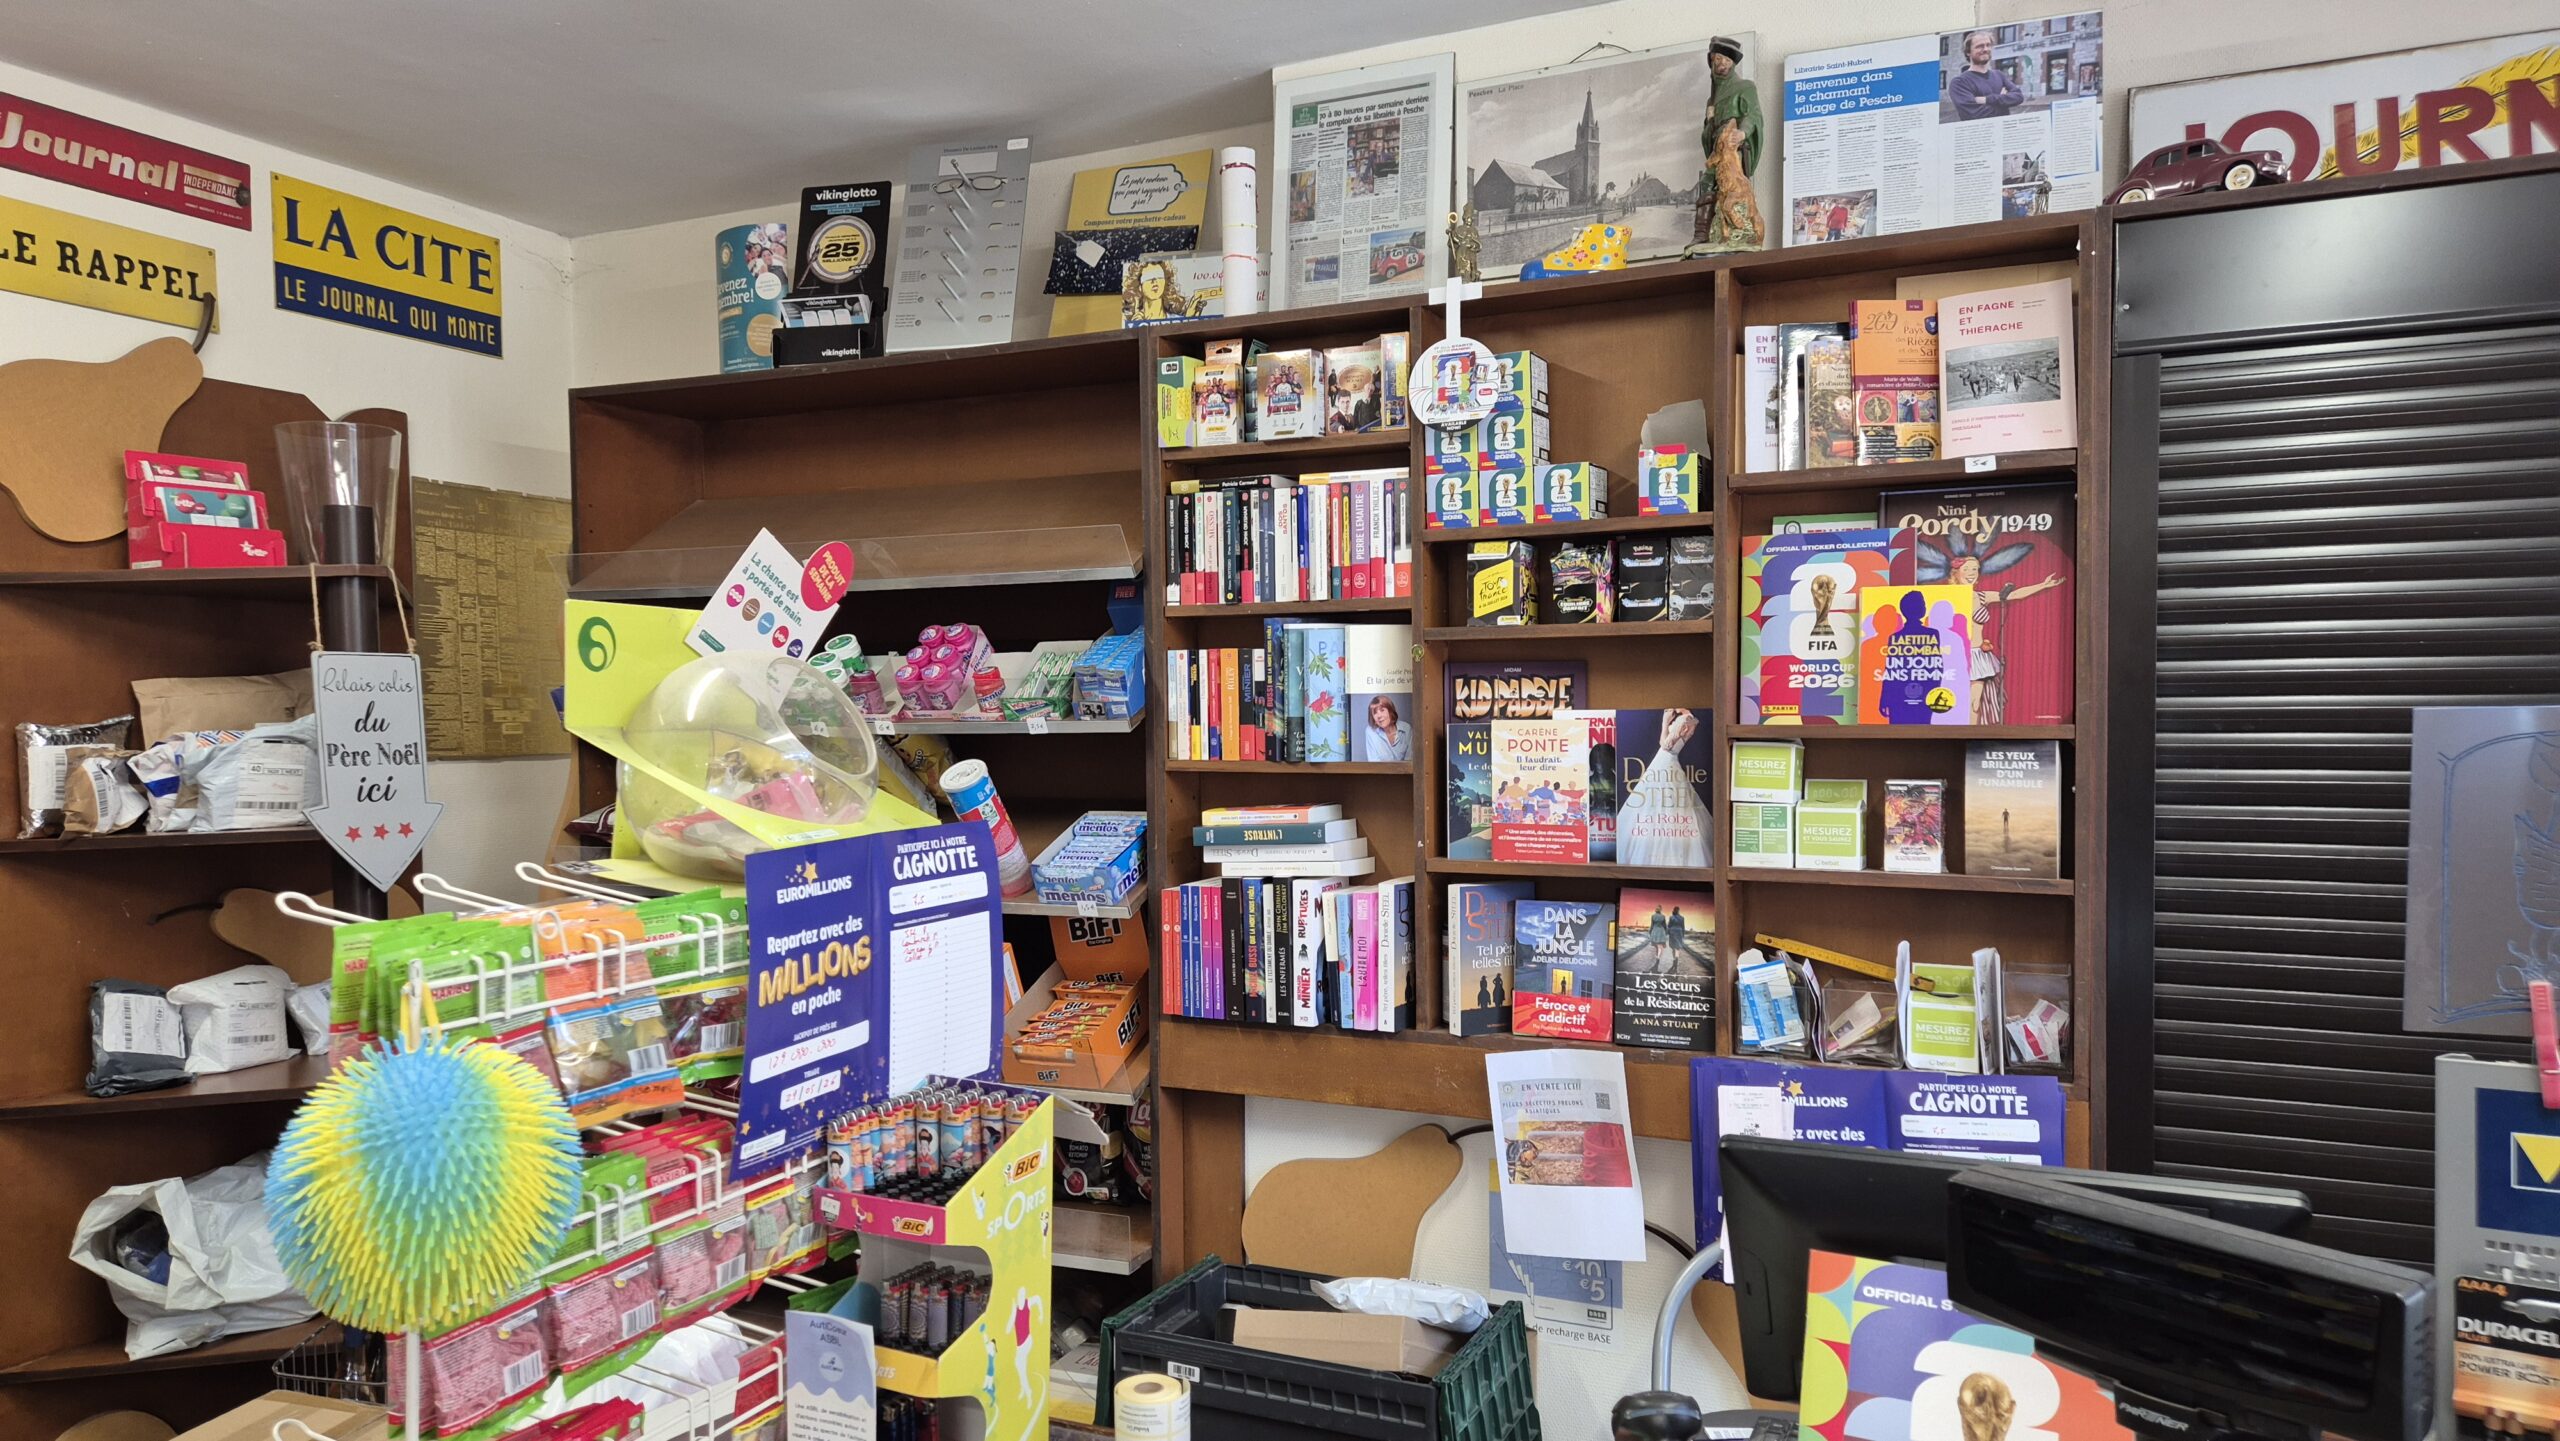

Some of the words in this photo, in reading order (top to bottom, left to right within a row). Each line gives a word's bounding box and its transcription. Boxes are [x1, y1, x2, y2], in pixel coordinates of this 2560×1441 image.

[1826, 57, 1873, 69] Saint-Hubert
[1794, 75, 1858, 91] Bienvenue
[1861, 69, 1893, 82] dans
[1794, 93, 1806, 104] le
[1808, 84, 1870, 101] charmant
[1343, 104, 1364, 115] heures
[1365, 103, 1377, 114] par
[1378, 99, 1404, 110] semaine
[1794, 102, 1836, 116] village
[1839, 98, 1856, 109] de
[1859, 93, 1904, 107] Pesche
[1326, 117, 1352, 129] comptoir
[1354, 114, 1362, 123] de
[1373, 110, 1395, 120] librairie
[1403, 105, 1424, 116] Pesche
[2185, 78, 2560, 182] OURN
[0, 111, 178, 191] Journal
[184, 174, 238, 199] INDEPENDANC
[816, 187, 878, 202] vikinglotto
[282, 195, 360, 260] LA
[375, 224, 494, 295] CITÉ
[822, 241, 860, 259] 25
[56, 240, 205, 302] RAPPEL
[283, 275, 307, 302] LE
[319, 285, 399, 324] JOURNAL
[409, 306, 437, 332] QUI
[447, 315, 496, 345] MONTE
[1959, 306, 1975, 317] EN
[1977, 300, 2015, 313] FAGNE
[1959, 316, 1972, 325] ET
[1959, 321, 2024, 336] THIERACHE
[1355, 493, 1365, 532] LEMAITRE
[1937, 504, 1967, 517] Nini
[1373, 512, 1381, 539] FRANCK
[1899, 511, 2002, 543] Cordy
[2000, 513, 2053, 532] 1949
[1356, 533, 1366, 561] PIERRE
[1765, 545, 1800, 553] OFFICIAL
[1802, 543, 1835, 551] STICKER
[1836, 541, 1887, 550] COLLECTION
[751, 551, 761, 568] La
[761, 562, 787, 593] chance
[786, 586, 799, 604] est
[818, 563, 829, 579] DE
[824, 575, 835, 590] LA
[822, 550, 846, 587] PRODUIT
[808, 566, 833, 604] SEMAINE
[746, 569, 774, 600] portée
[773, 594, 785, 609] de
[782, 605, 803, 628] main.
[1808, 639, 1838, 652] FIFA
[1891, 634, 1939, 646] LAETITIA
[1879, 645, 1951, 657] COLOMBANI
[1789, 663, 1830, 674] WORLD
[1831, 663, 1855, 673] CUP
[1885, 657, 1906, 669] UN
[1906, 657, 1943, 669] JOUR
[322, 667, 375, 693] Relais
[379, 669, 414, 693] colis
[1788, 673, 1855, 689] 2026
[1873, 668, 1911, 682] SANS
[1912, 668, 1957, 682] FEMME
[1455, 677, 1493, 718] KID
[1493, 675, 1573, 718] PADDLE
[354, 700, 390, 734] du
[1517, 725, 1558, 737] CARÈNE
[1507, 738, 1569, 752] PONTE
[326, 743, 372, 768] Père
[376, 742, 421, 766] Noël
[1526, 754, 1562, 765] faudrait
[1985, 752, 2003, 761] LES
[2004, 751, 2035, 761] YEUX
[1519, 764, 1537, 772] leur
[1539, 763, 1557, 771] dire
[1622, 756, 1708, 785] Danielle
[1738, 759, 1787, 770] MESUREZ
[1981, 760, 2040, 770] BRILLANTS
[1977, 778, 2043, 788] FUNAMBULE
[1996, 770, 2024, 779] D'UN
[356, 775, 397, 803] ici
[1635, 813, 1654, 825] La
[1656, 812, 1694, 825] Robe
[1243, 829, 1284, 840] L'INTRUSE
[1631, 826, 1649, 838] de
[1651, 826, 1698, 838] mariée
[1803, 827, 1852, 837] MESUREZ
[893, 846, 979, 880] CAGNOTTE
[777, 875, 852, 904] EUROMILLIONS
[1045, 890, 1106, 904] mentos
[1298, 889, 1308, 939] RUPTURES
[1544, 907, 1587, 924] DANS
[767, 928, 818, 956] Repartez
[819, 921, 845, 943] avec
[845, 915, 863, 935] des
[1066, 915, 1124, 944] BiFi
[1556, 924, 1574, 939] LA
[1356, 935, 1367, 953] MOI
[1476, 944, 1493, 957] Tel
[1535, 938, 1595, 957] JUNGLE
[758, 935, 873, 1007] MILLIONS
[1472, 955, 1501, 970] telles
[1300, 967, 1311, 1009] MINIER
[1635, 975, 1657, 989] Les
[1660, 977, 1701, 993] Sœurs
[791, 998, 807, 1016] en
[807, 986, 842, 1015] poche
[1535, 996, 1576, 1010] Féroce
[1578, 1002, 1591, 1013] et
[1624, 996, 1635, 1006] de
[1636, 997, 1644, 1007] la
[1647, 994, 1710, 1012] Résistance
[1117, 1000, 1142, 1048] BiFi
[1539, 1010, 1587, 1026] addictif
[1632, 1017, 1660, 1027] ANNA
[1662, 1019, 1700, 1030] STUART
[1915, 1023, 1970, 1034] MESUREZ
[1037, 1071, 1061, 1082] BiFi
[1521, 1083, 1533, 1092] EN
[1534, 1082, 1560, 1091] VENTE
[1918, 1084, 1965, 1093] PARTICIPEZ
[1966, 1084, 1979, 1093] ICI
[1980, 1081, 1987, 1094] À
[1988, 1085, 2017, 1094] NOTRE
[1909, 1092, 2029, 1115] CAGNOTTE
[1806, 1130, 1837, 1142] avec
[1840, 1127, 1866, 1142] des
[1015, 1155, 1039, 1179] BiC
[986, 1186, 1048, 1239] SPORTS
[901, 1218, 925, 1234] BiC
[1579, 1278, 1606, 1302] €5
[1863, 1286, 1937, 1310] OFFICIAL
[1532, 1325, 1544, 1334] de
[1546, 1326, 1586, 1342] recharge
[1587, 1333, 1612, 1345] BASE
